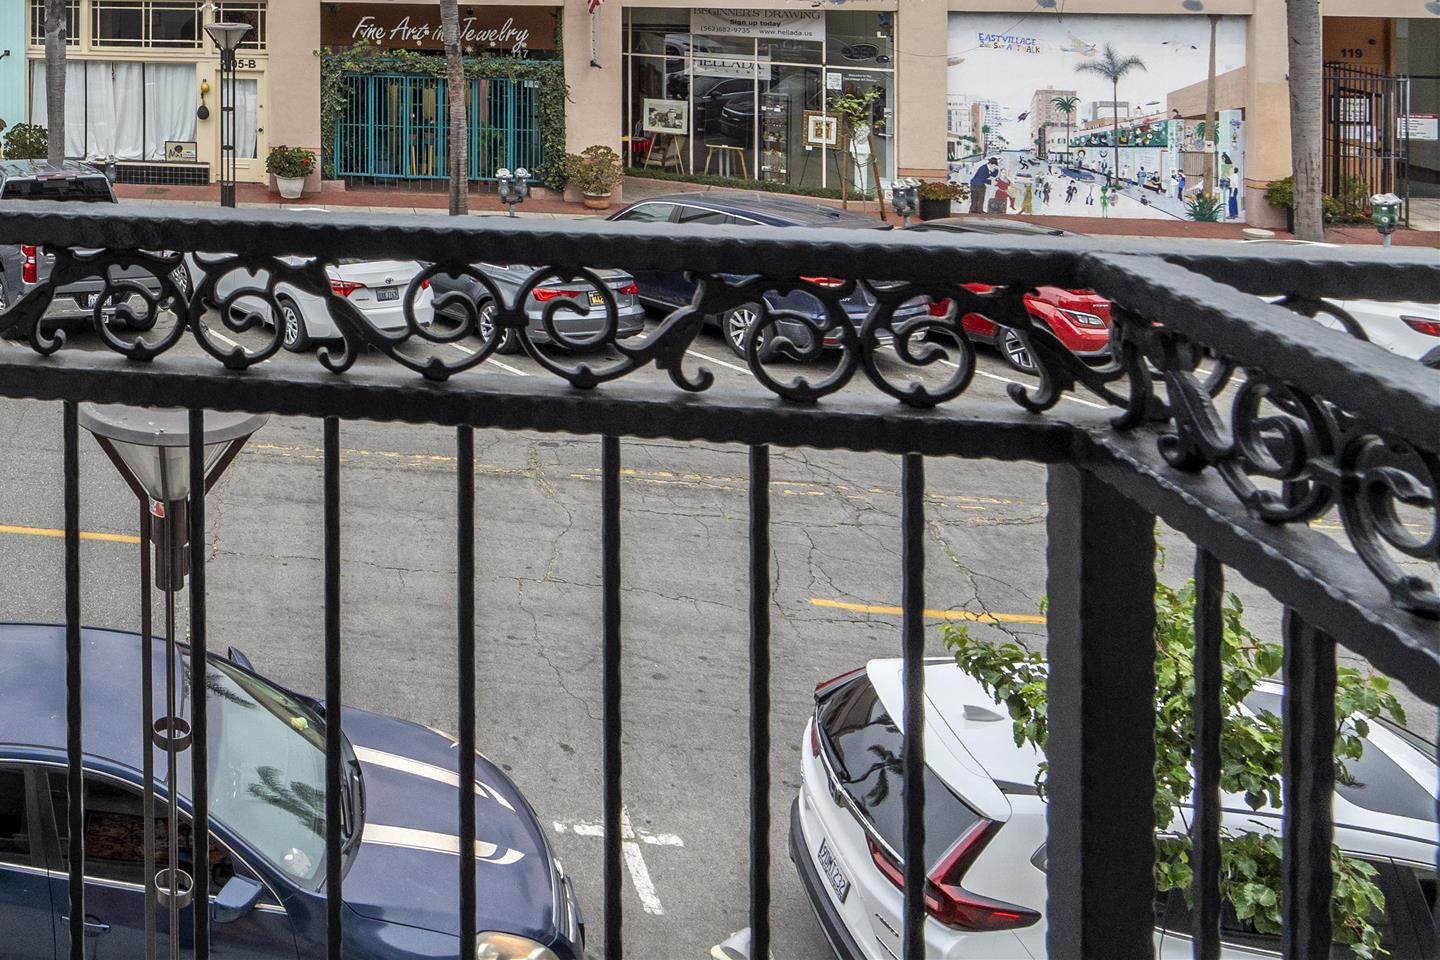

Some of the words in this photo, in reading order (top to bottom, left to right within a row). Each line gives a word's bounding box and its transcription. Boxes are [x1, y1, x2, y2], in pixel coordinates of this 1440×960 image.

[764, 9, 820, 19] DRAWING
[352, 16, 385, 40] Fine
[389, 16, 429, 41] Art
[459, 17, 529, 52] Jewelry
[700, 25, 751, 34] (562)682-9735
[1341, 48, 1363, 58] 119
[231, 59, 256, 69] 05-B
